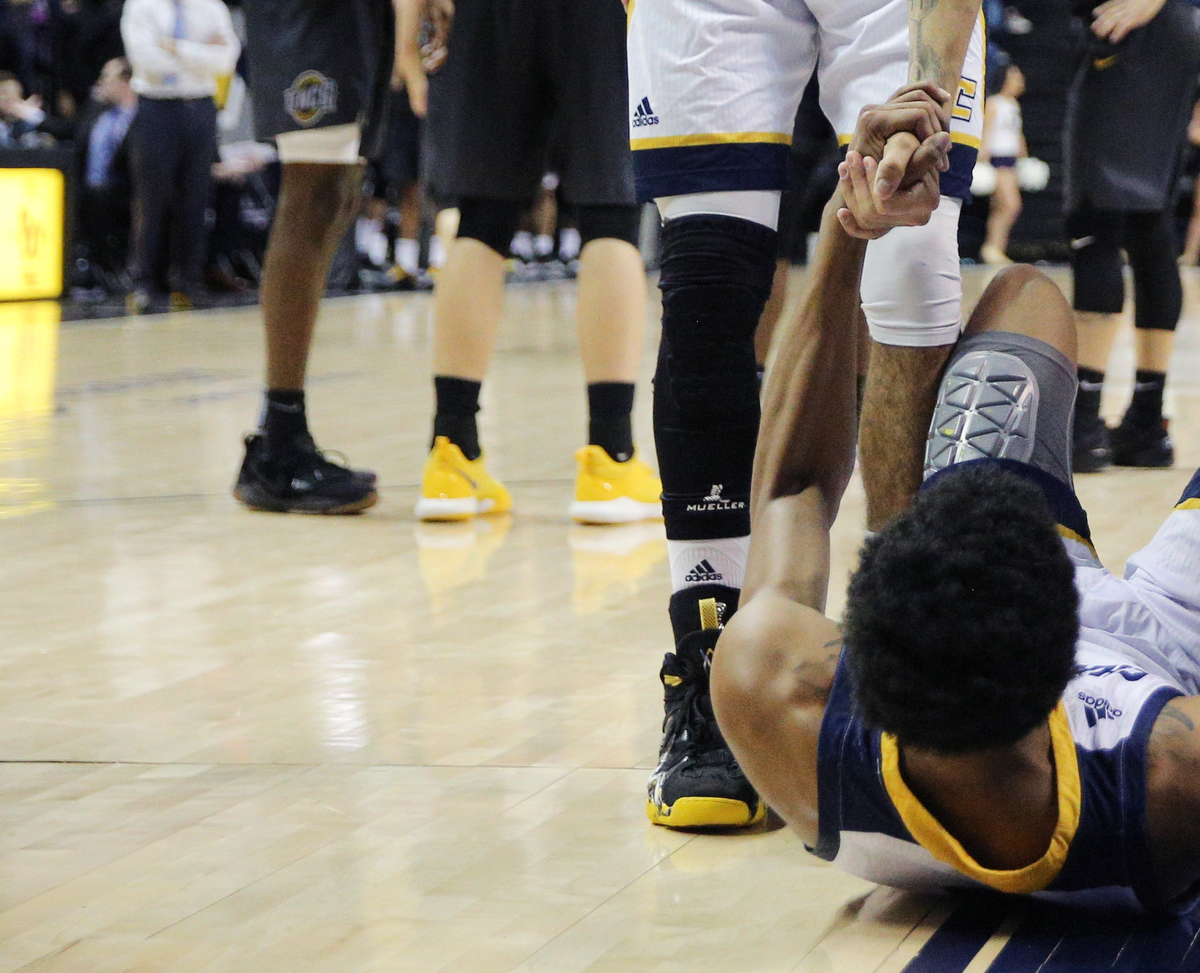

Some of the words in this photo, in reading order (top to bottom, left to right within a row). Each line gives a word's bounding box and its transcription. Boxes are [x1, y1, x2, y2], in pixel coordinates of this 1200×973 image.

[686, 501, 746, 512] MUELLER
[685, 572, 723, 582] adidas
[1077, 691, 1123, 718] adidas
